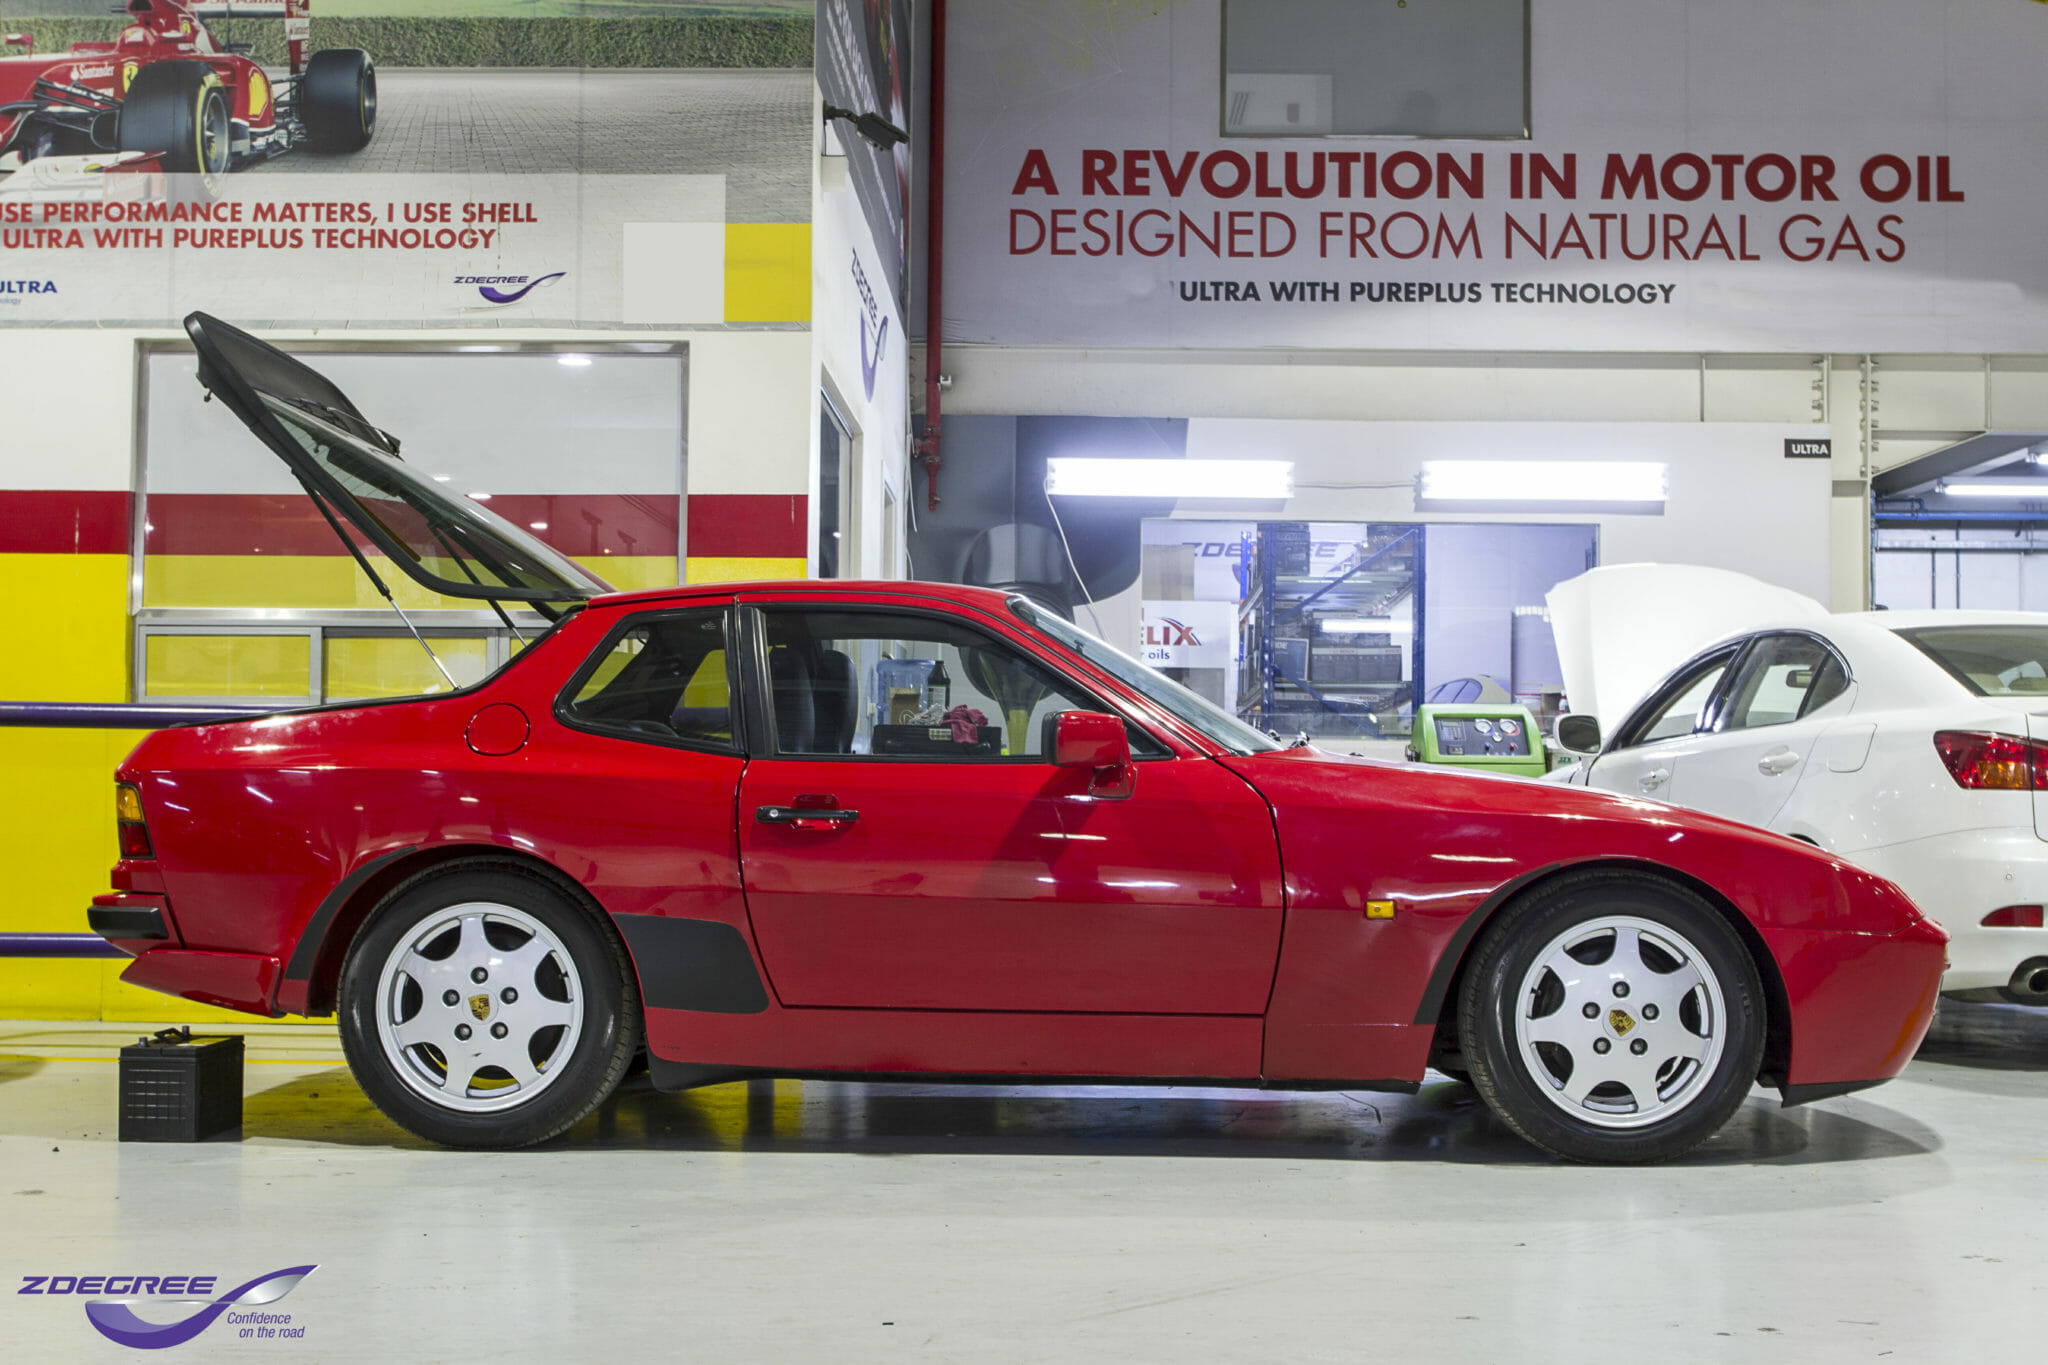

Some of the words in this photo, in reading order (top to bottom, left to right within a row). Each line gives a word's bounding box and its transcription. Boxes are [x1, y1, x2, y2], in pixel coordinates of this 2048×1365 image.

[1012, 149, 1059, 195] A
[1083, 150, 1484, 199] REVOLUTION
[1510, 152, 1577, 200] IN
[1601, 152, 1839, 202] MOTOR
[1860, 154, 1965, 203] OIL
[0, 202, 33, 223] SE
[43, 202, 243, 223] PERFORMANCE
[252, 202, 377, 226] MATTERS,
[387, 202, 394, 223] I
[403, 202, 451, 223] USE
[462, 202, 537, 223] SHELL
[3, 228, 84, 249] ULTRA
[93, 228, 163, 249] WITH
[173, 228, 304, 249] PUREPLUS
[312, 228, 496, 250] TECHNOLOGY
[1009, 208, 1297, 258] DESIGNED
[1319, 211, 1483, 259] FROM
[1505, 213, 1761, 261] NATURAL
[1778, 214, 1906, 263] GAS
[453, 275, 529, 284] ZDEGREE
[1180, 281, 1261, 302] ULTRA
[1269, 281, 1340, 302] WITH
[1350, 281, 1482, 303] PUREPLUS
[1491, 282, 1676, 304] TECHNOLOGY
[1791, 443, 1829, 454] ULTRA
[1141, 626, 1198, 646] LIX
[1148, 648, 1170, 660] oils
